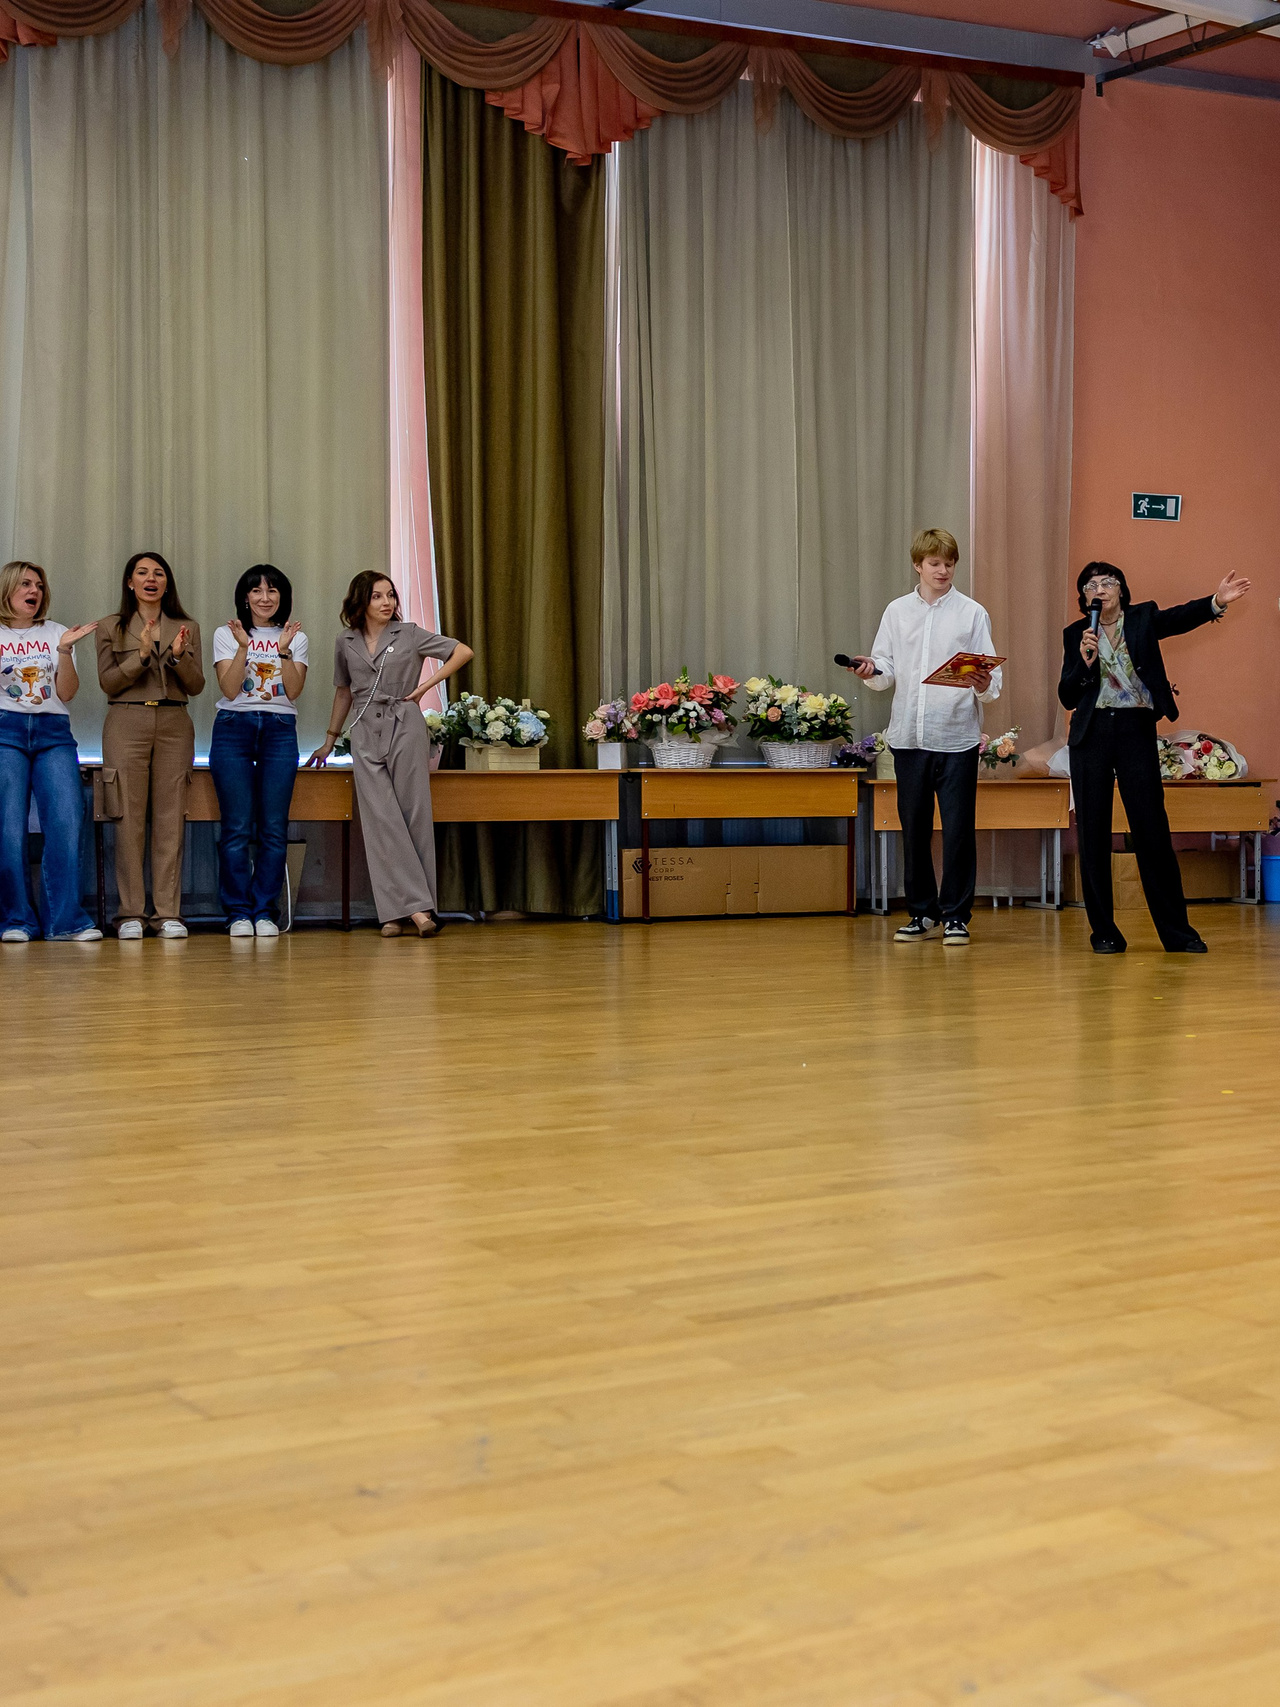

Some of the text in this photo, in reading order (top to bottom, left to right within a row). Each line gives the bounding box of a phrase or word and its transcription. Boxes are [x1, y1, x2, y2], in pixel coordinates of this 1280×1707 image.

[0, 640, 51, 656] МАМА
[248, 640, 279, 653] МАМ
[653, 857, 694, 866] TESSA
